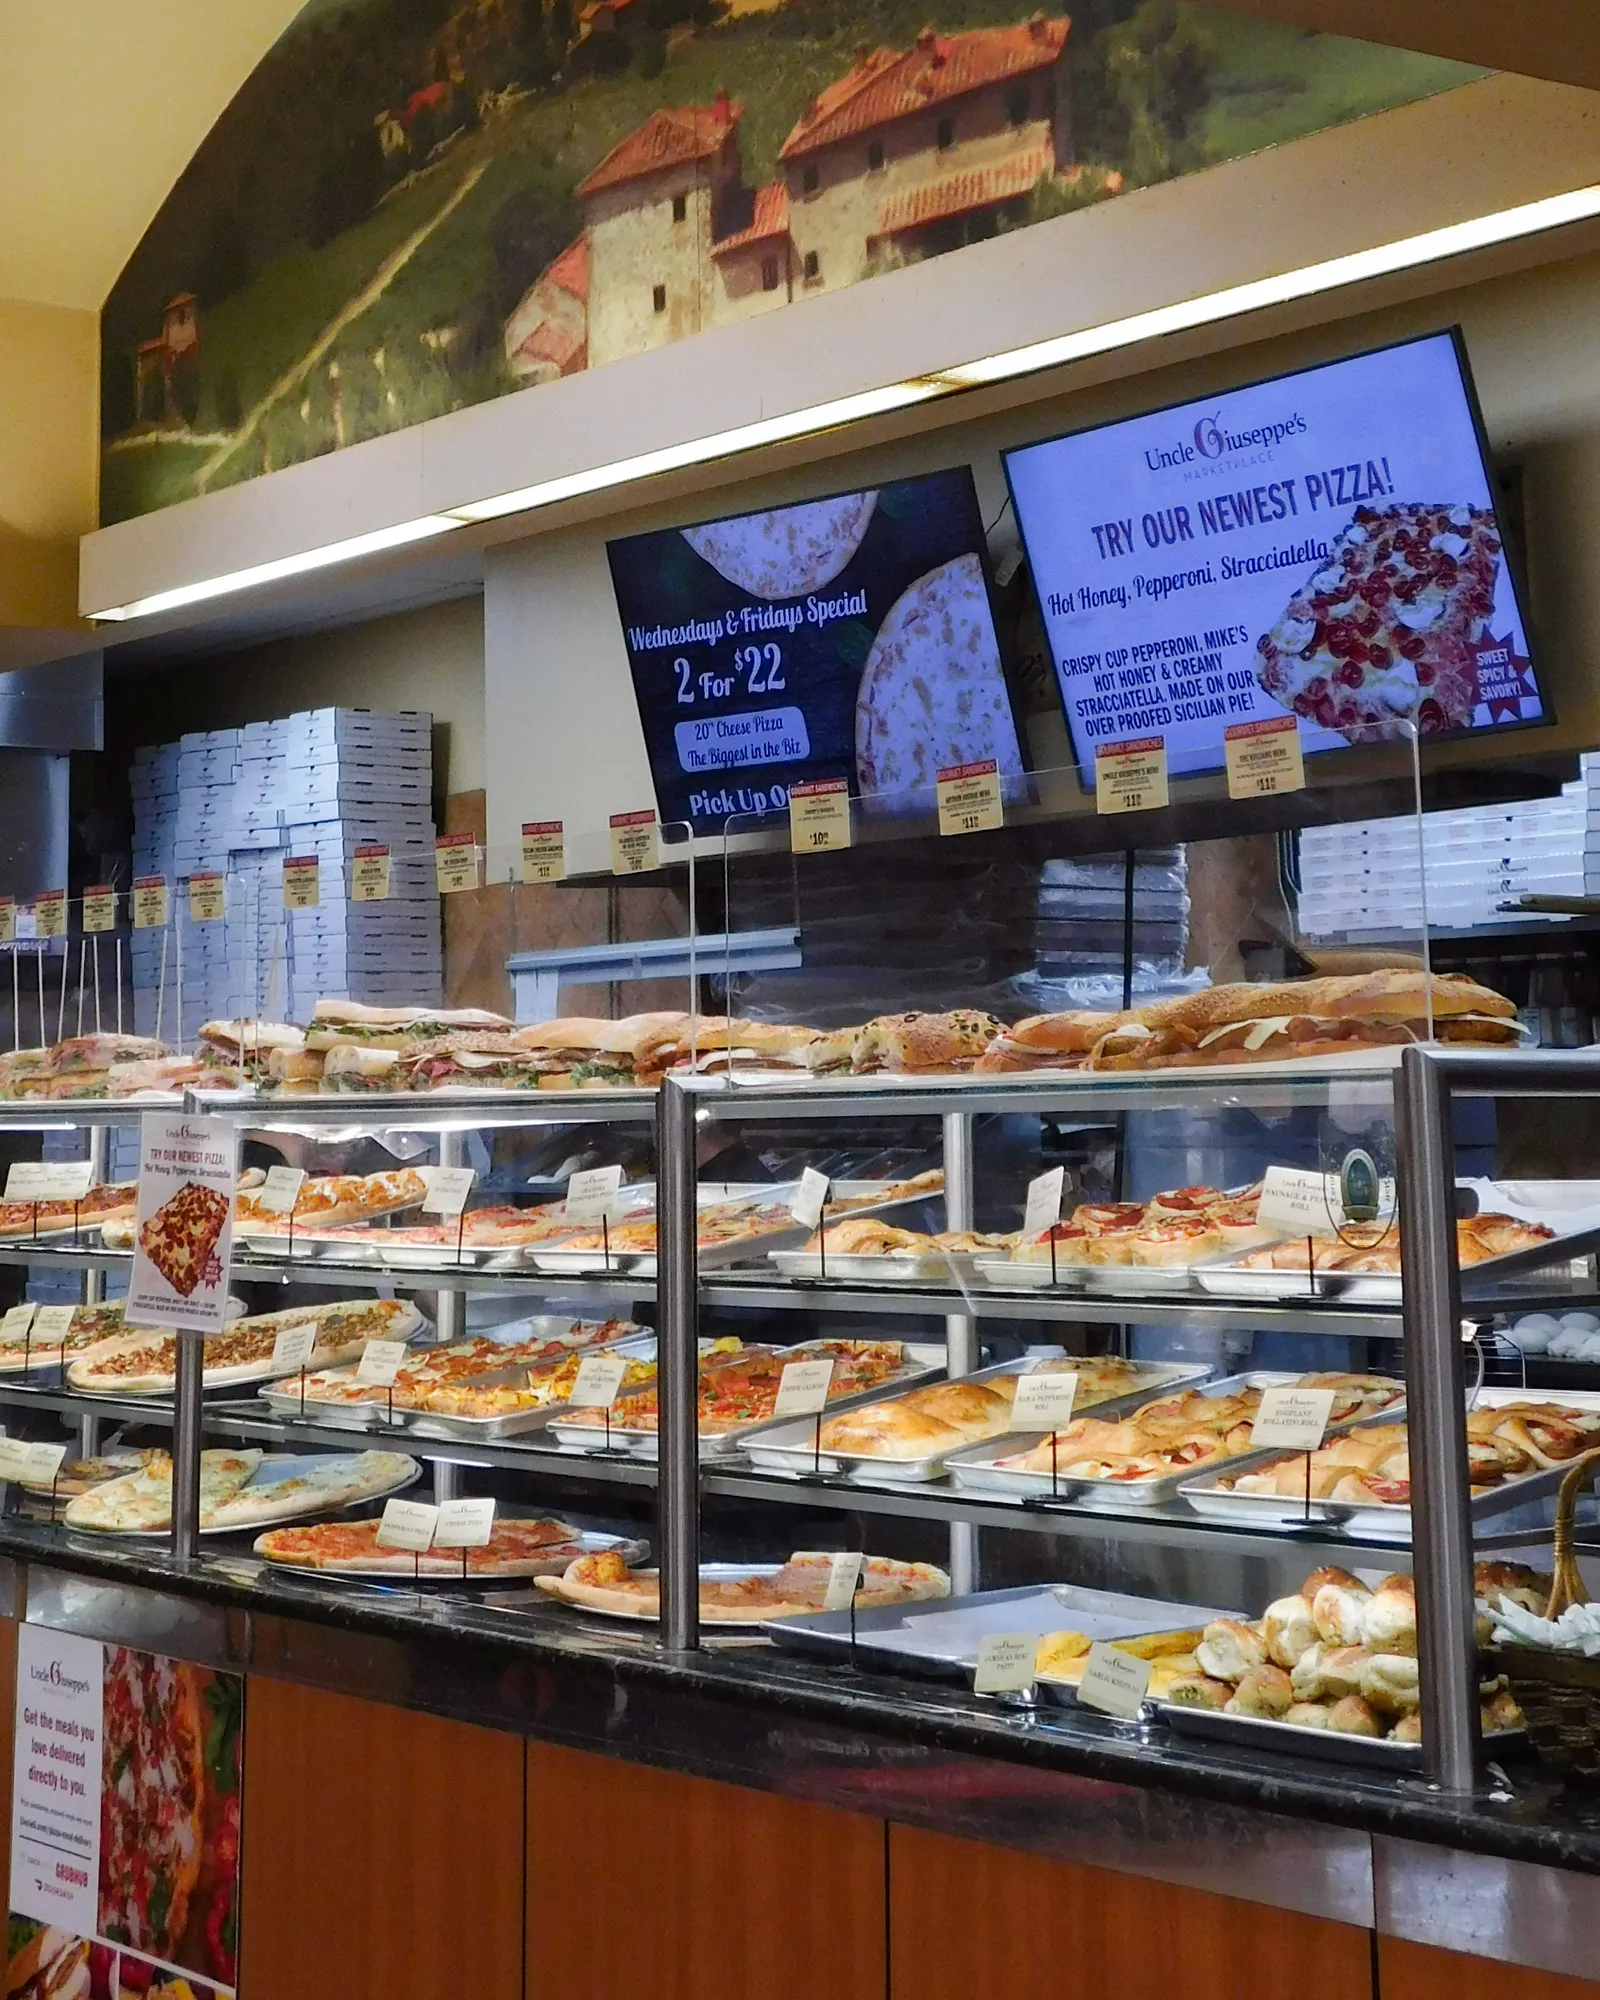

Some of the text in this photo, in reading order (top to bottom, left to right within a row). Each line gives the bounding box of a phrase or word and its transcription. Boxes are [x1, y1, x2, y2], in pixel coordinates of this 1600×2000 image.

[1145, 410, 1307, 471] Uncle Giuseppe's
[1184, 451, 1274, 482] MARKETPLACE
[1091, 456, 1395, 560] TRY OUR NEWEST PIZZA!
[1047, 593, 1075, 616] Hot
[1133, 561, 1217, 601] Pepperoni,
[1221, 538, 1329, 580] Stracciatella
[627, 588, 868, 652] Wednesdays & Fridays Special
[1062, 624, 1249, 677] CRISPY CUP PEPPERONI, MIKE'S
[1476, 648, 1509, 667] SWEET
[674, 642, 786, 704] 2 For $22
[1093, 652, 1223, 693] HOT HONEY & CREAMY
[1167, 678, 1205, 701] MADE
[1206, 674, 1225, 695] ON
[1227, 669, 1255, 690] OUR
[1476, 665, 1505, 684] SPICY
[1480, 681, 1523, 701] SAVORY!
[716, 720, 751, 738] Cheese
[752, 715, 784, 733] Pizza
[1085, 692, 1255, 737] OVER PROOFED SICILIAN PIE!
[687, 738, 801, 769] The Biggest in the Biz
[689, 789, 736, 816] Pick
[736, 787, 767, 817] Up
[150, 1148, 226, 1166] TRY OUR NEWEST PIZZA!
[24, 1707, 95, 1742] Get the meals you
[31, 1737, 85, 1768] love delivered
[28, 1765, 87, 1797] directly to you.
